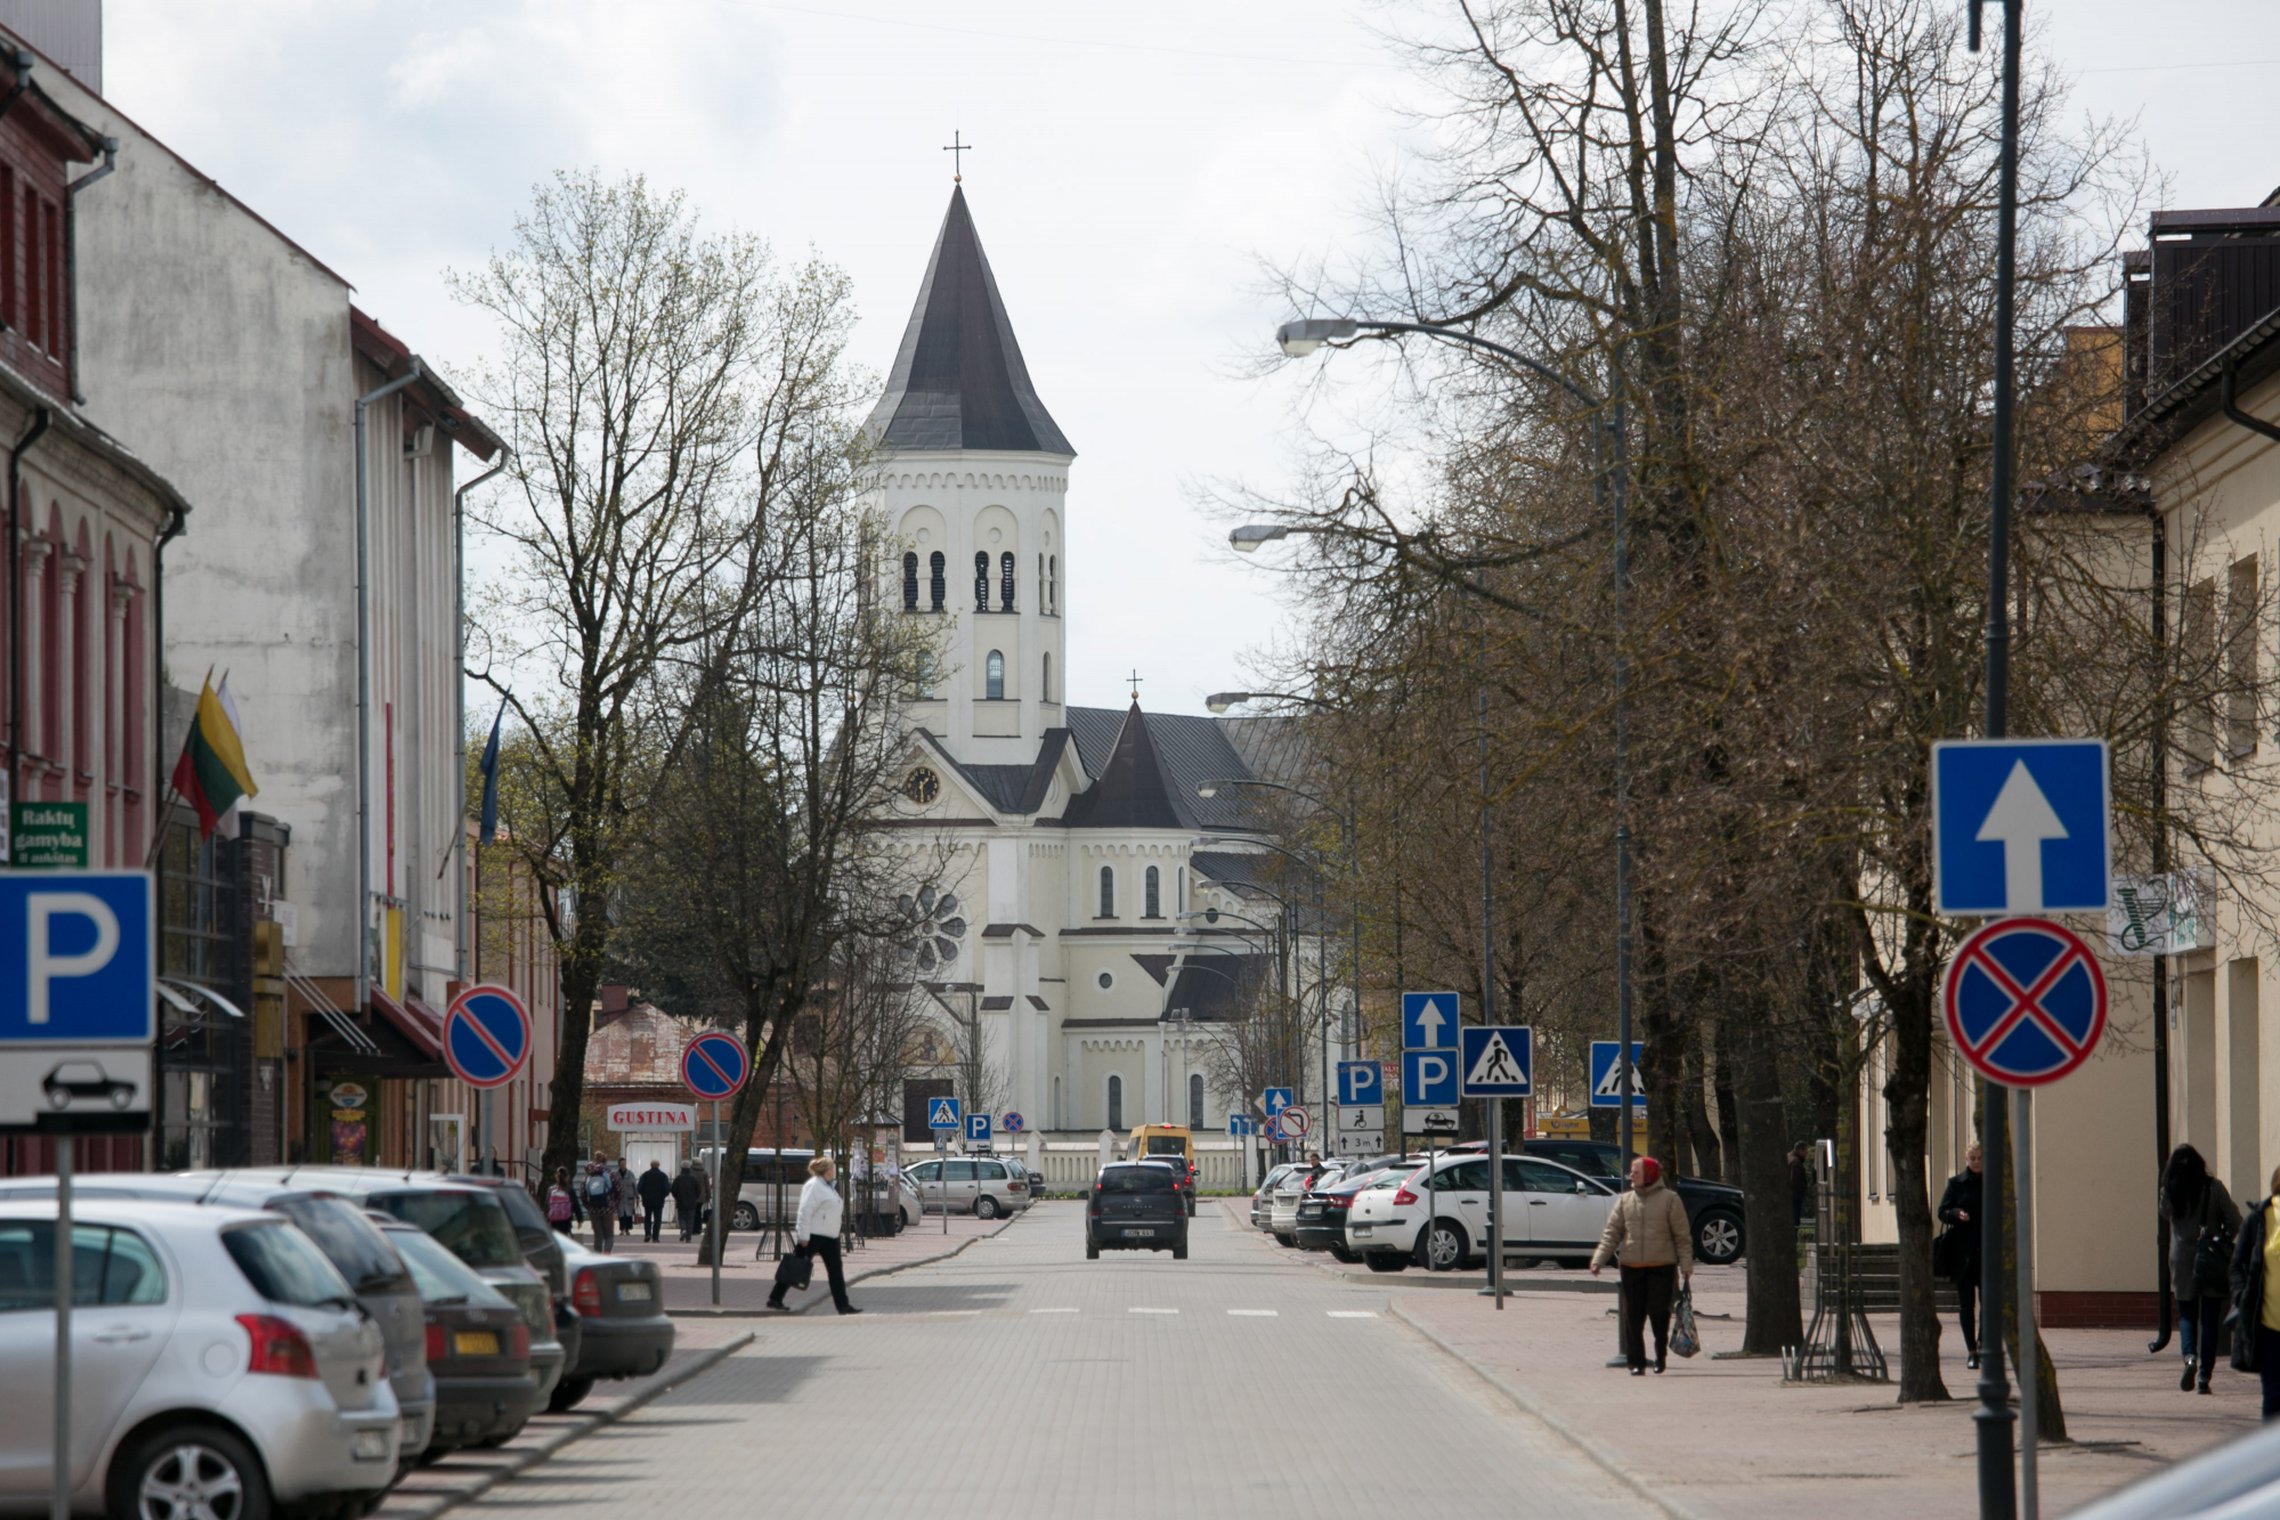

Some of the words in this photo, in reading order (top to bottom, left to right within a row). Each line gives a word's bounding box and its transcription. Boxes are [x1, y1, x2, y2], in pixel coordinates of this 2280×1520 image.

[22, 810, 76, 829] Raktų
[15, 832, 83, 851] gamyba
[27, 891, 121, 1024] P
[1350, 1066, 1375, 1101] P
[1418, 1056, 1449, 1100] P
[612, 1110, 688, 1125] GUSTINA
[973, 1117, 987, 1137] P
